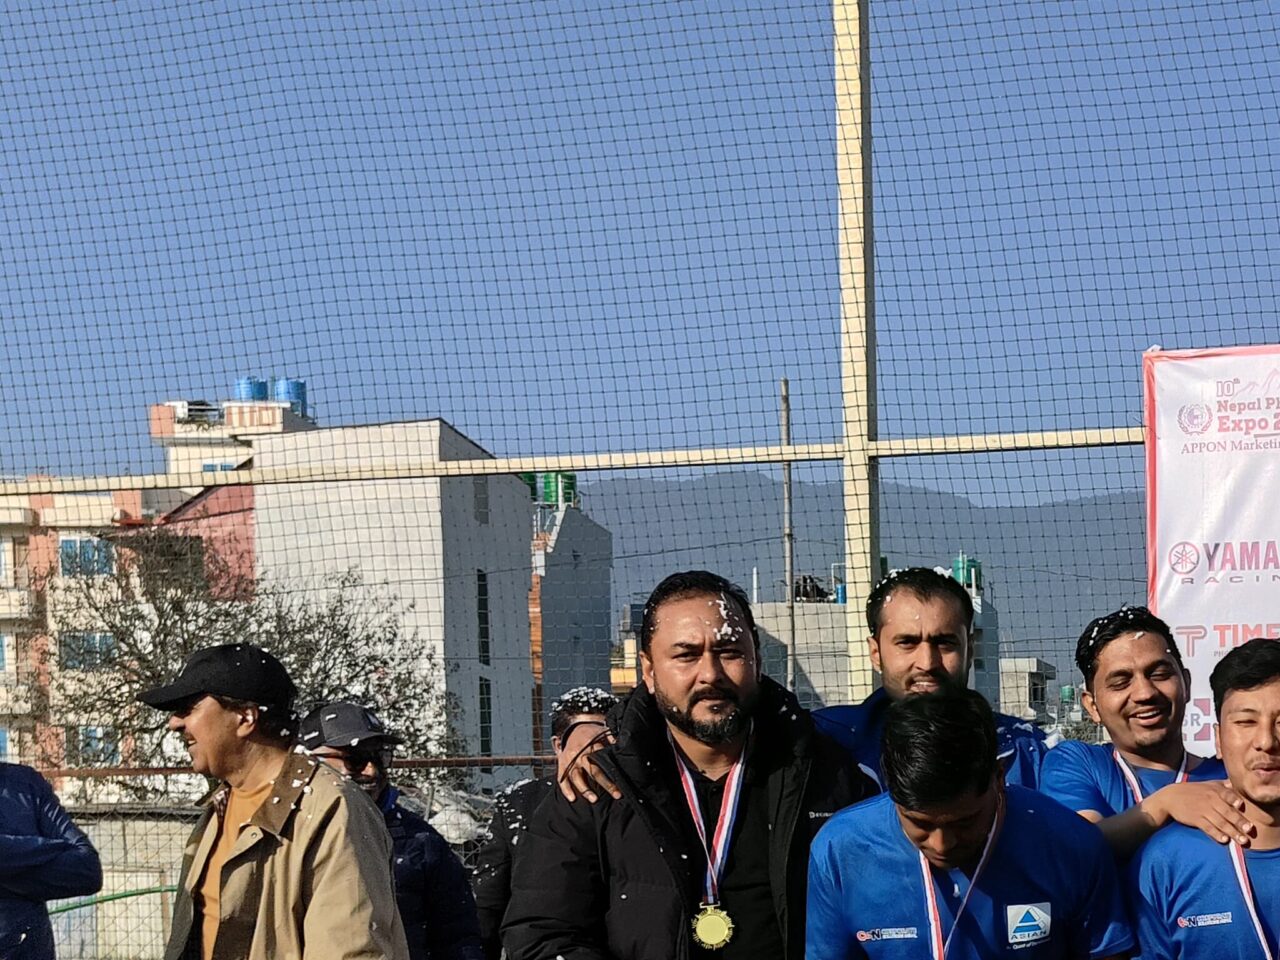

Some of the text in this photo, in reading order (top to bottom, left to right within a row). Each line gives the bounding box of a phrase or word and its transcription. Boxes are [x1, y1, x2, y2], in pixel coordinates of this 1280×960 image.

[1216, 398, 1262, 414] Nepal
[1217, 415, 1269, 435] Expo
[1181, 440, 1227, 454] APPON
[1010, 930, 1047, 941] ASIAN
